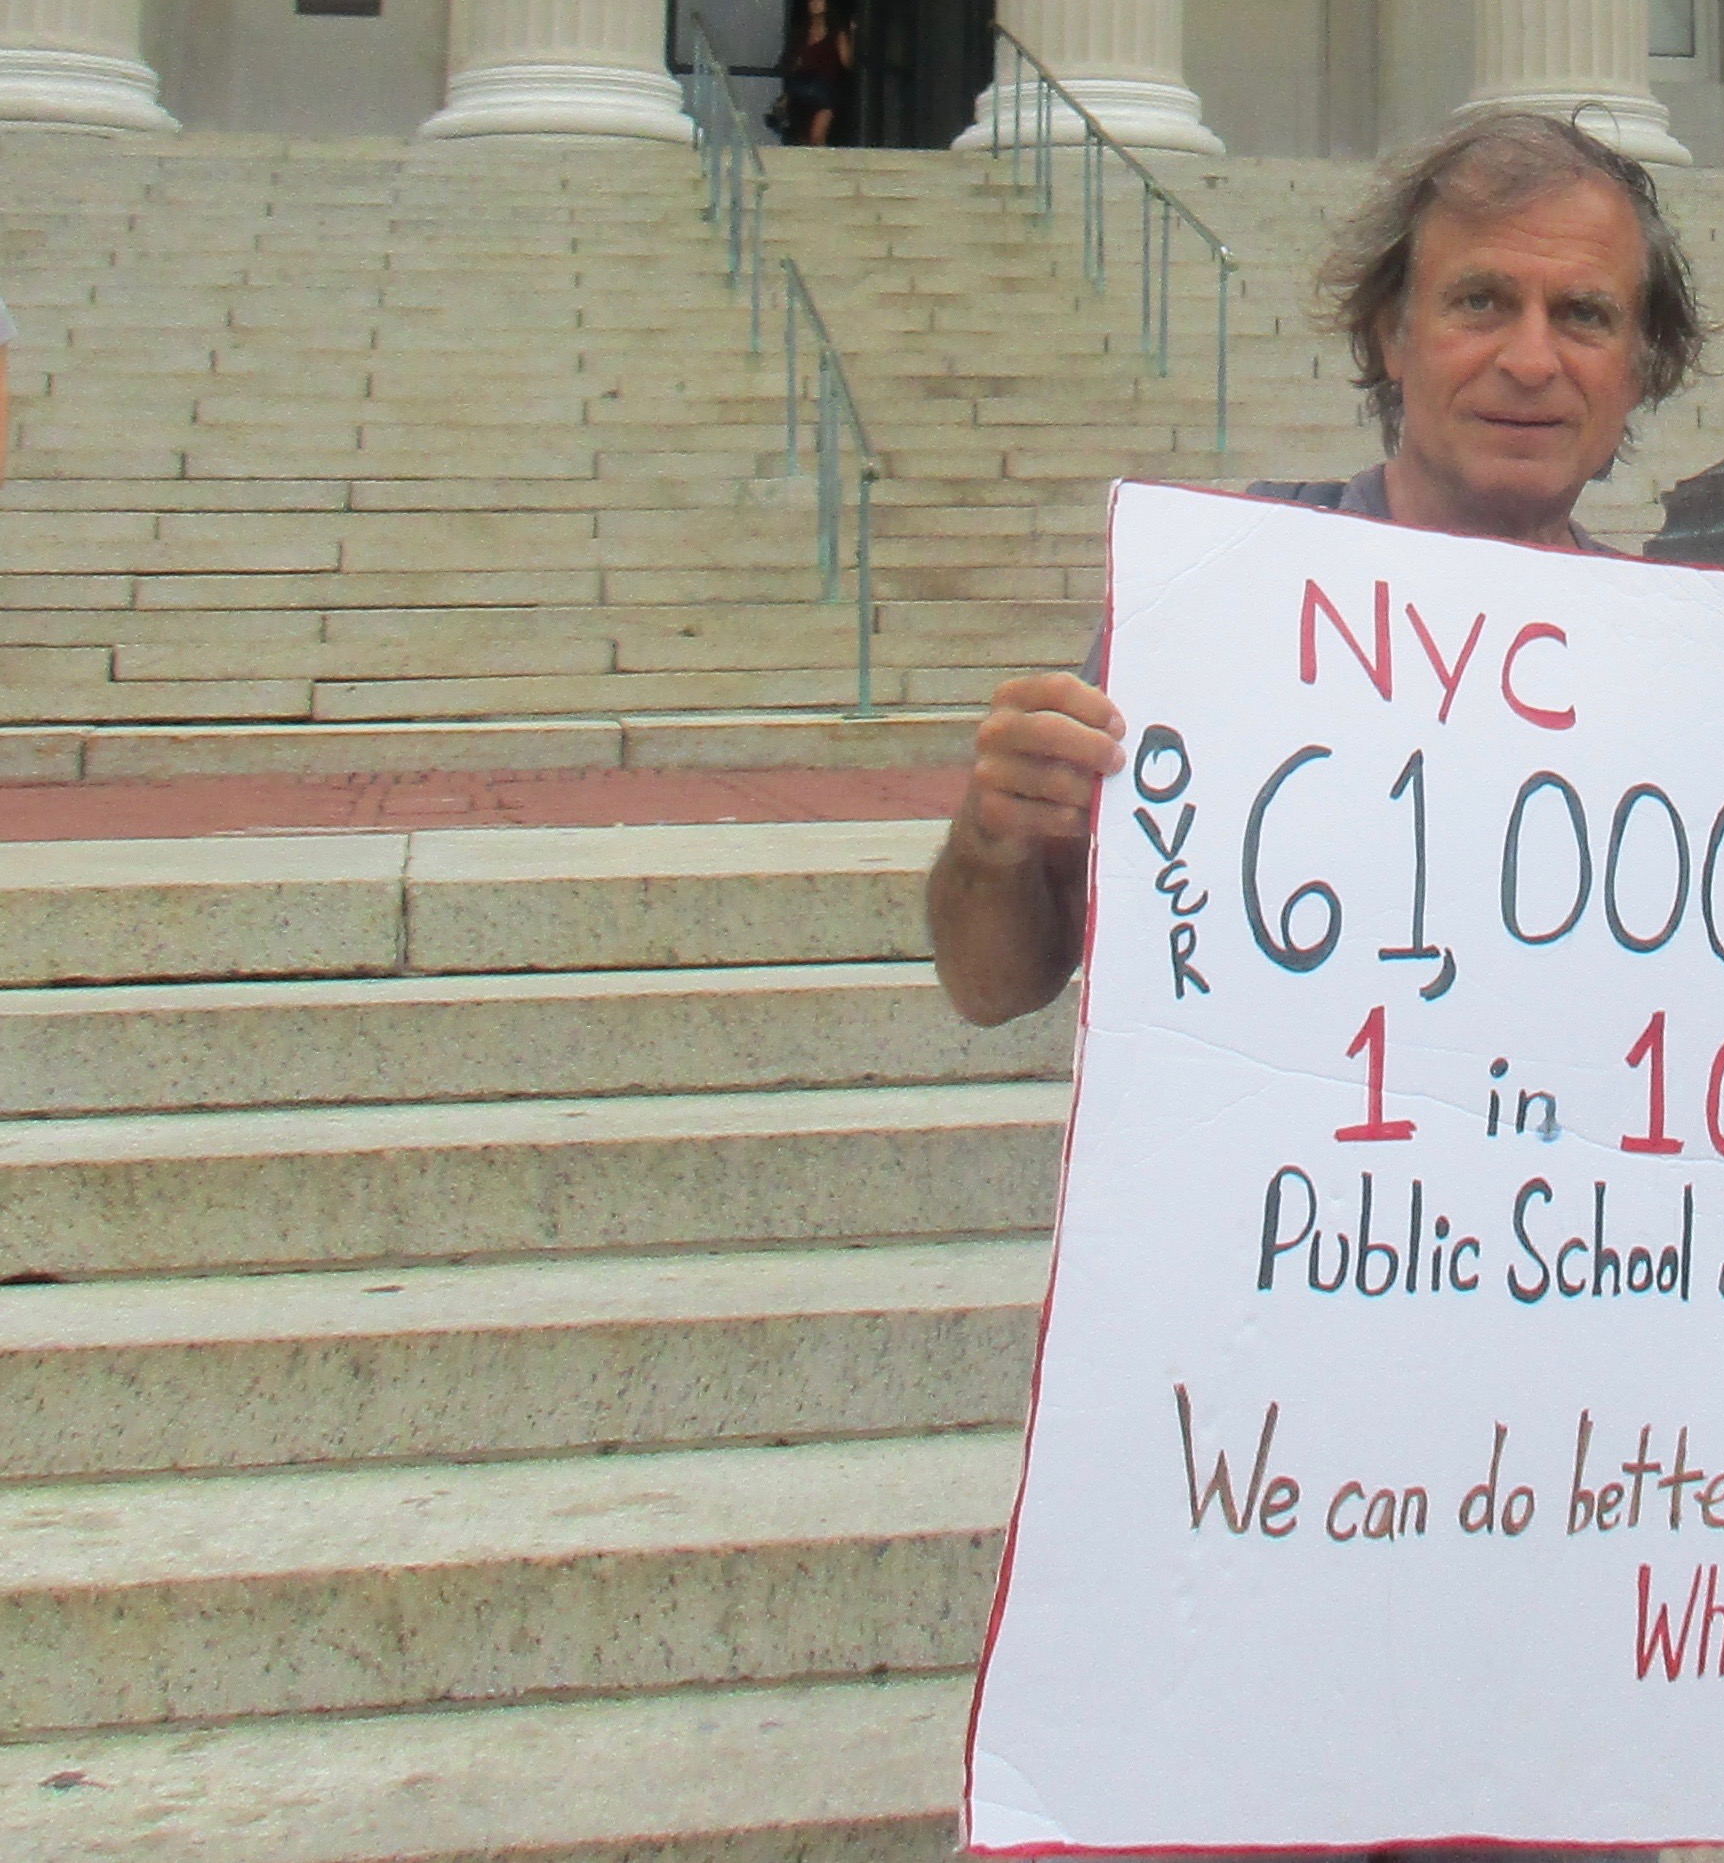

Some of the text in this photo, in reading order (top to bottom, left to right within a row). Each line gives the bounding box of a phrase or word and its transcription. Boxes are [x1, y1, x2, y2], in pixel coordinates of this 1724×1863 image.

[1300, 579, 1577, 730] NYC
[1133, 725, 1210, 999] OVER
[1335, 1006, 1416, 1141] 1
[1488, 1057, 1560, 1142] in
[1256, 1164, 1480, 1297] Public
[1507, 1177, 1694, 1304] School
[1174, 1383, 1300, 1536] We
[1325, 1480, 1426, 1542] can
[1459, 1420, 1536, 1535] do
